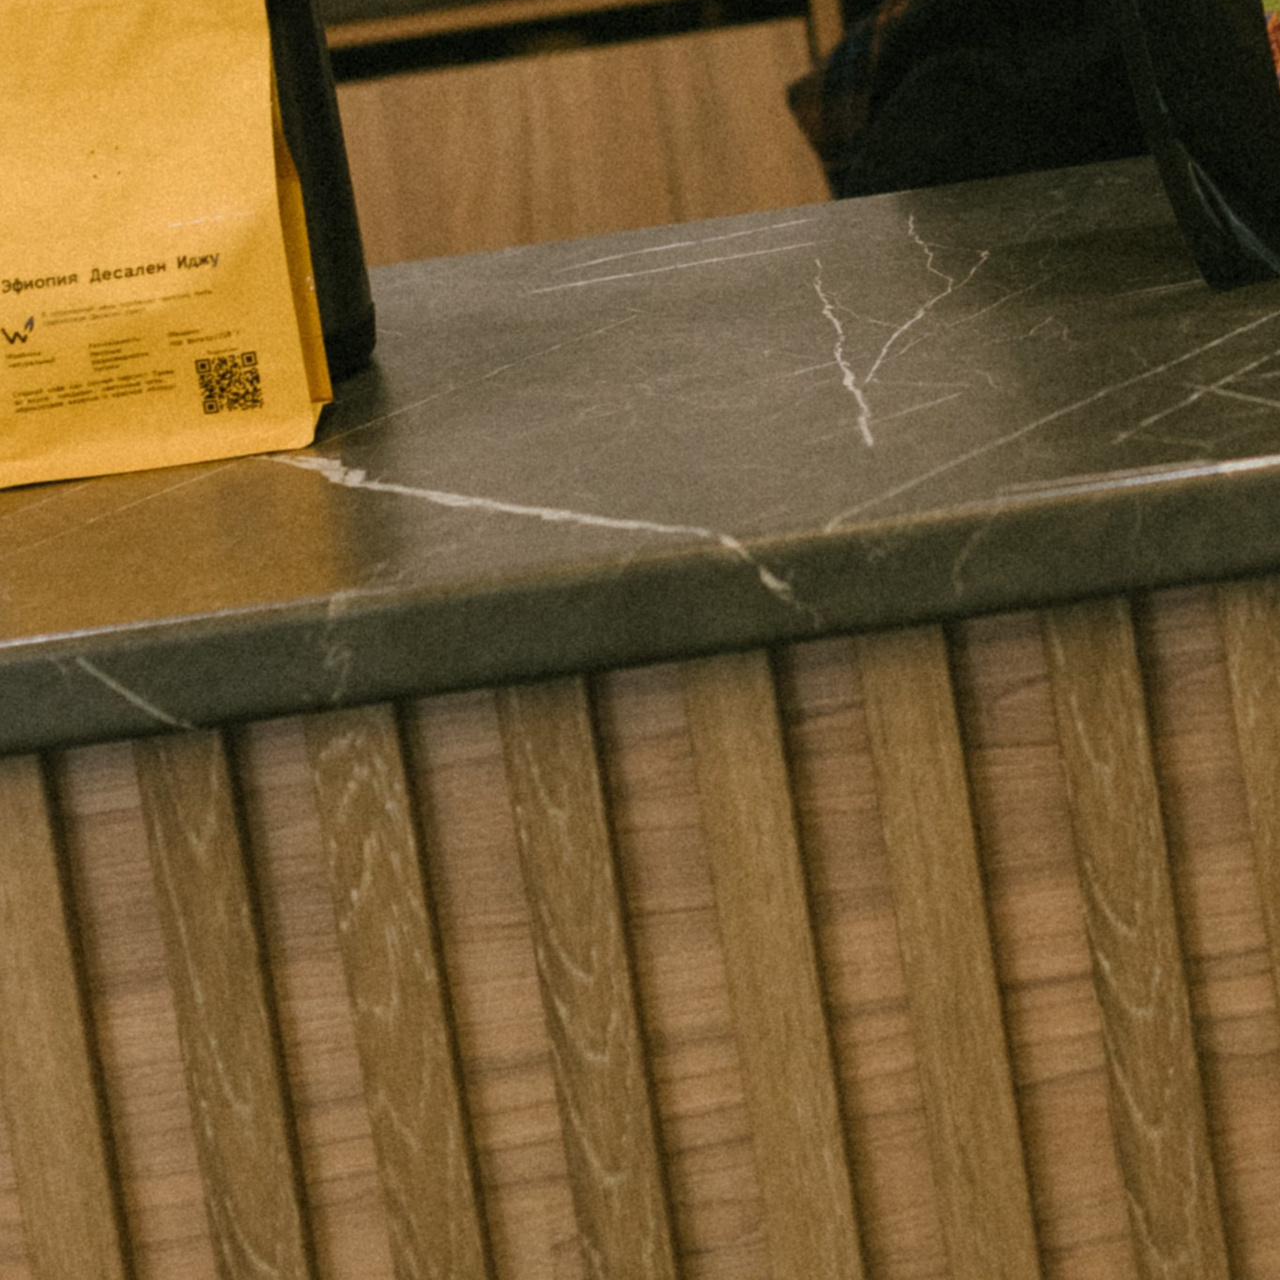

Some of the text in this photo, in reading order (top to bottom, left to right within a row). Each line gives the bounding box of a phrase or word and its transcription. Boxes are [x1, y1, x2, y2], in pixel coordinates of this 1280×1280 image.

[1, 252, 221, 295] Эфиопия Десален Иджу
